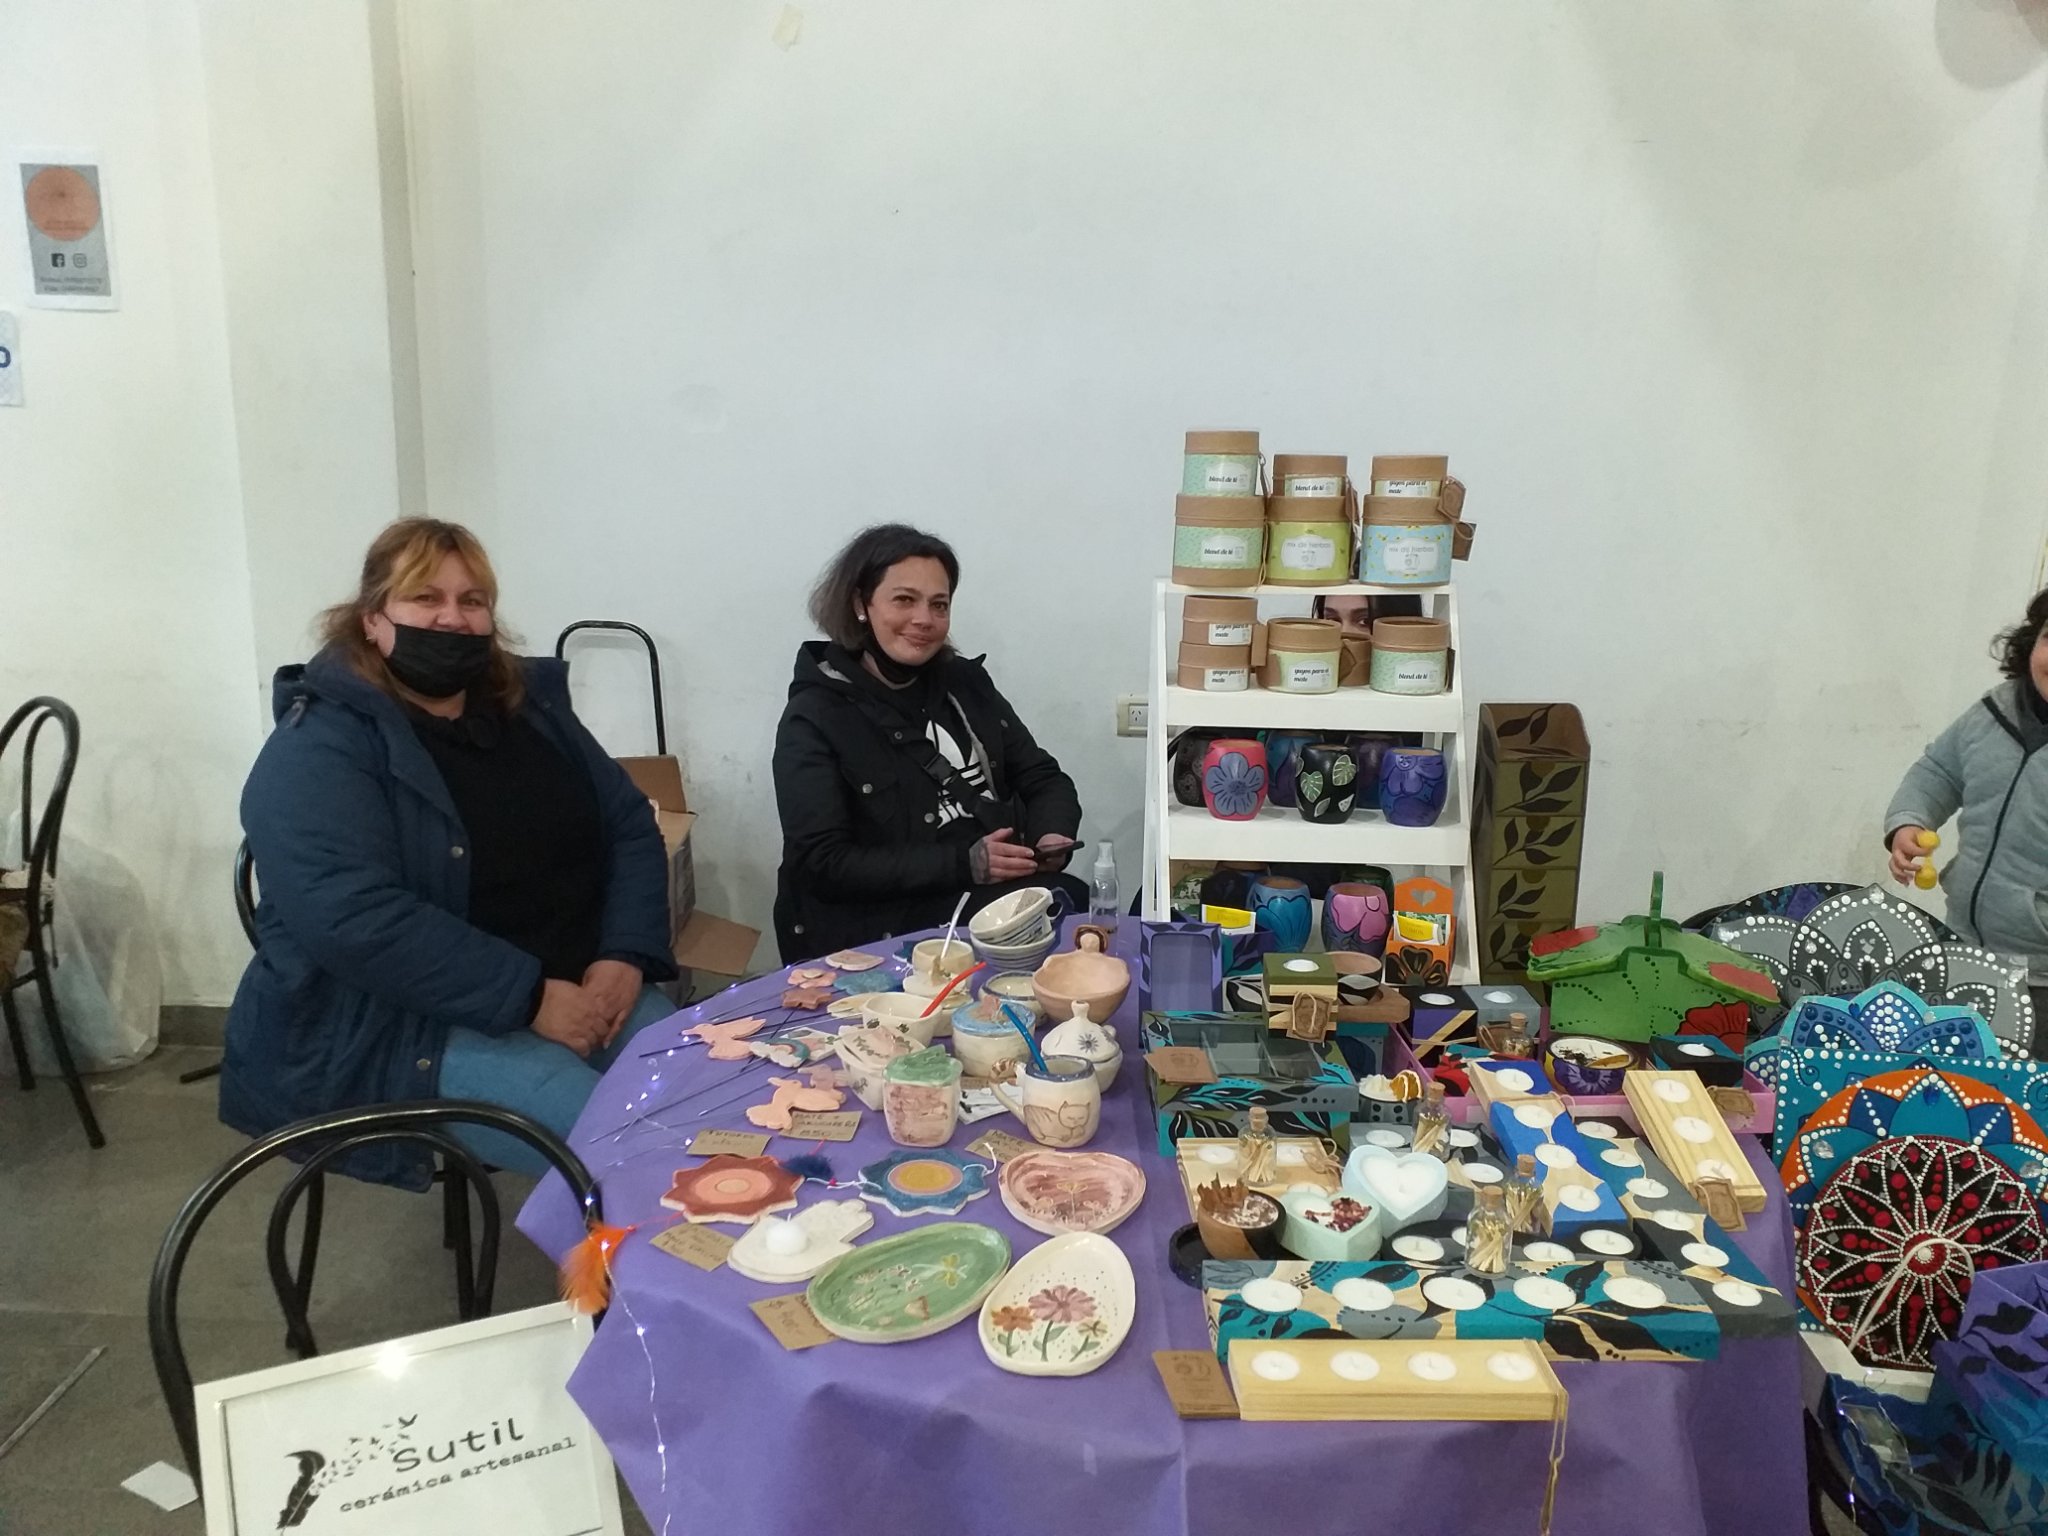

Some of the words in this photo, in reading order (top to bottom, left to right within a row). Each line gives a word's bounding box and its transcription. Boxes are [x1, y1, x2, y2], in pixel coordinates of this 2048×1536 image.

[1225, 475, 1232, 483] de
[392, 1417, 525, 1473] Sutil
[339, 1475, 454, 1513] cerámica
[460, 1436, 577, 1480] artesanal
